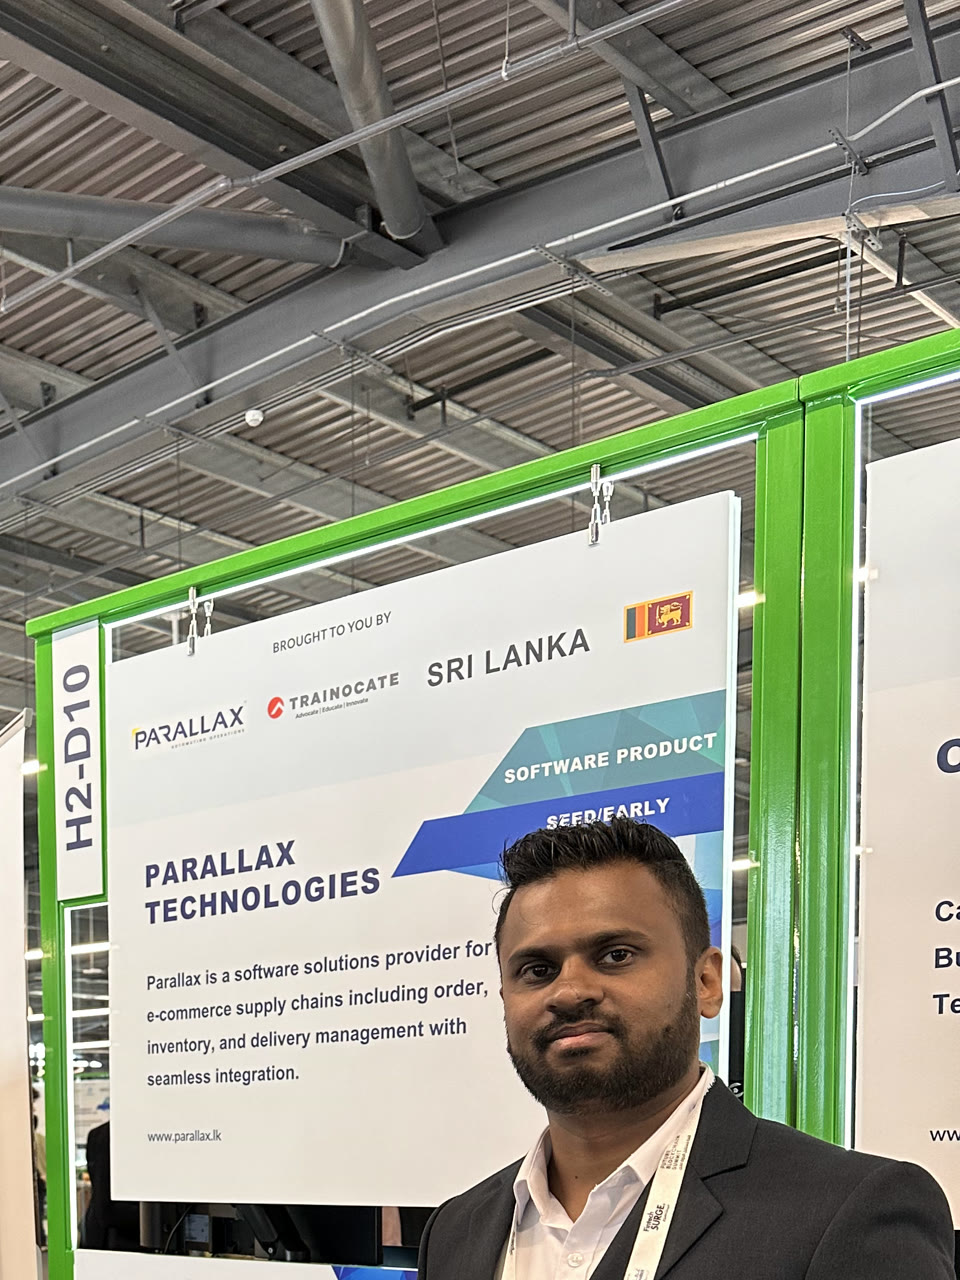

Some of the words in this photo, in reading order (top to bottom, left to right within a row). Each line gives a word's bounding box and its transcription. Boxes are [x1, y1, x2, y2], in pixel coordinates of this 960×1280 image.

[272, 628, 328, 654] BROUGHT
[329, 623, 345, 639] TO
[347, 616, 373, 635] YOU
[376, 610, 392, 627] BY
[427, 654, 473, 687] SRI
[485, 628, 590, 675] LANKA
[290, 672, 400, 710] TRAINOCATE
[295, 707, 319, 719] Advocate
[322, 702, 343, 713] Educate
[134, 705, 245, 750] PARALLAX
[63, 663, 93, 852] H2-D10
[504, 752, 609, 784] SOFTWARE
[616, 733, 718, 764] PRODUCT
[546, 797, 670, 830] SEED/EARLY
[145, 840, 296, 888] PARALLAX
[145, 867, 381, 925] TECHNOLOGIES
[146, 970, 202, 991] Parallax
[205, 969, 218, 985] is
[221, 970, 230, 983] a
[234, 961, 299, 982] software
[303, 953, 380, 976] solutions
[385, 942, 460, 971] provider
[466, 940, 493, 958] for
[146, 1003, 232, 1023] e-commerce
[236, 997, 286, 1017] supply
[291, 992, 344, 1012] chains
[348, 984, 428, 1007] including
[434, 979, 488, 999] order,
[146, 1036, 216, 1055] inventory,
[219, 1033, 246, 1051] and
[250, 1029, 311, 1050] delivery
[315, 1020, 424, 1046] management
[429, 1017, 468, 1036] with
[146, 1070, 211, 1087] seamless
[214, 1065, 300, 1087] integration.
[146, 1128, 222, 1144] www.parallax.lk
